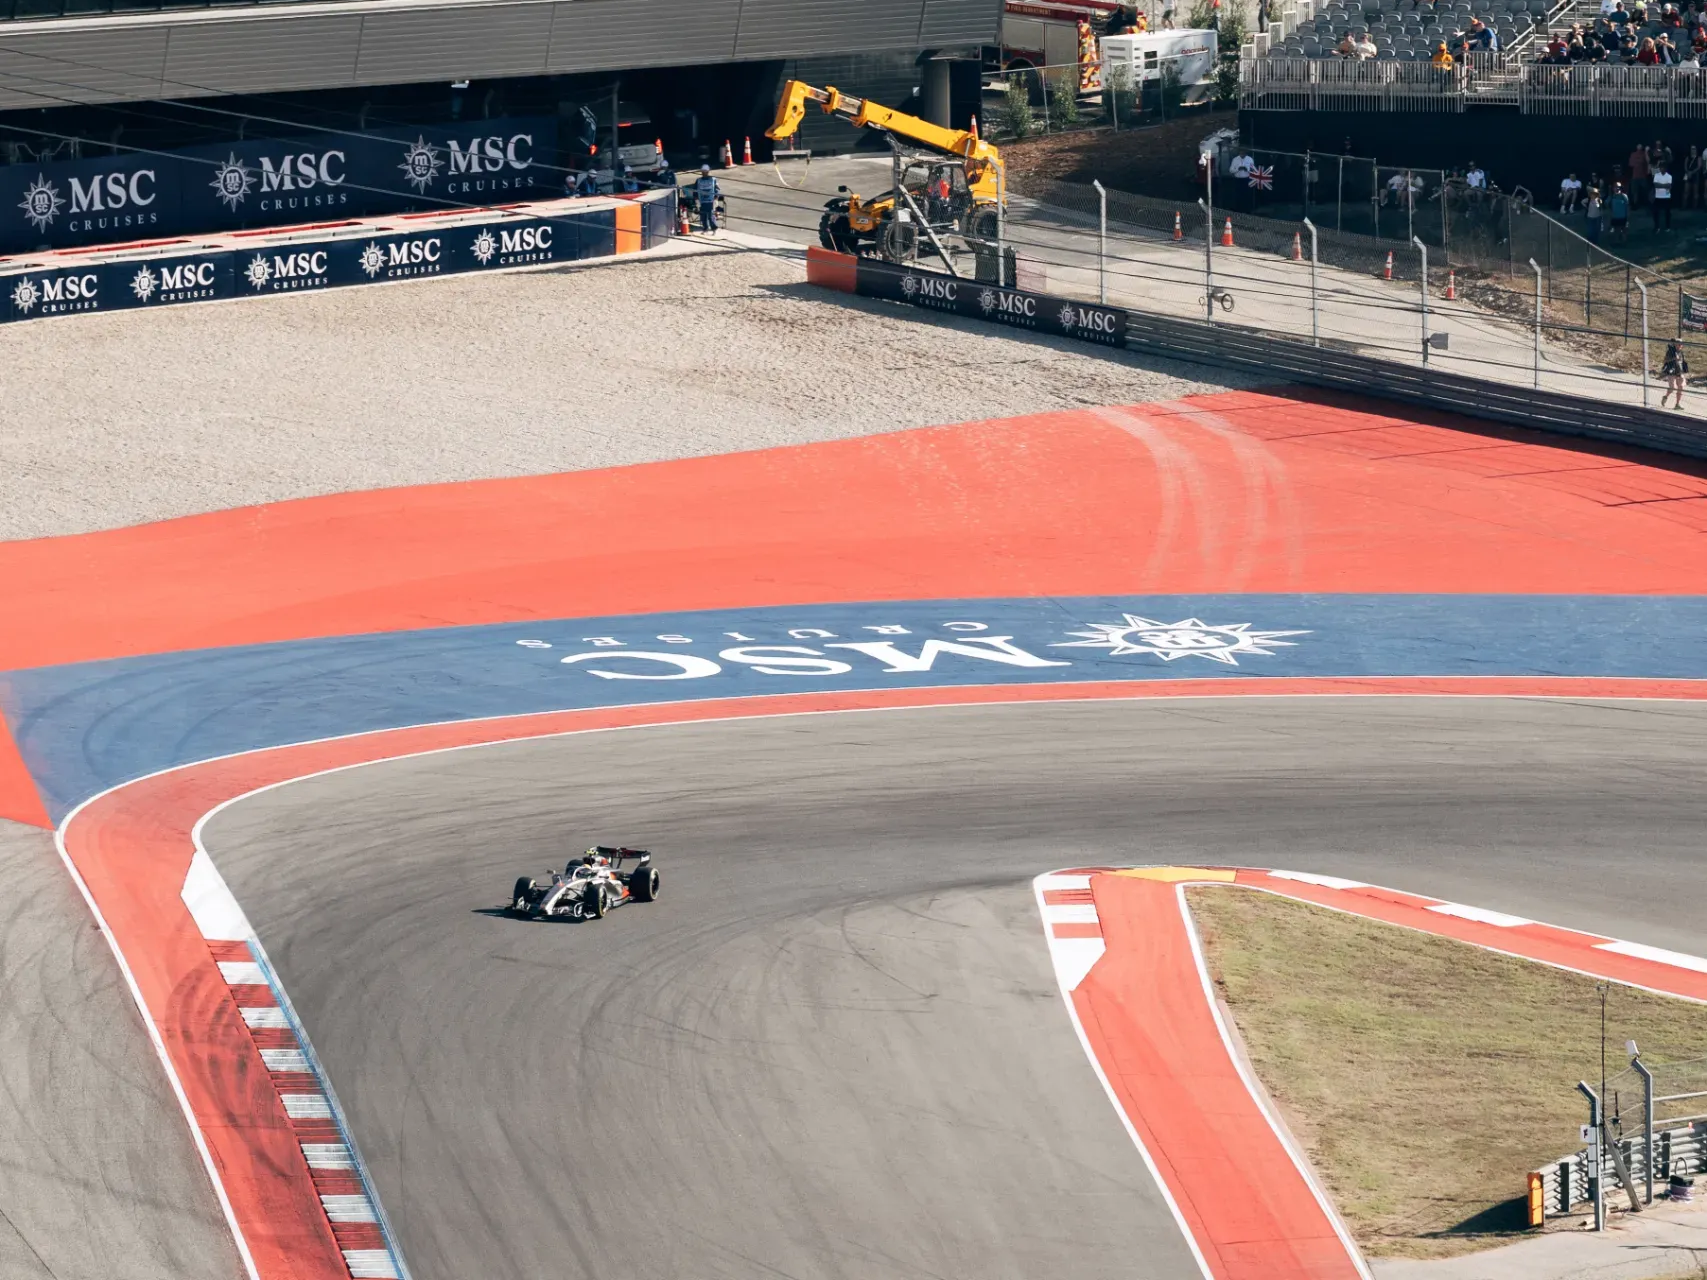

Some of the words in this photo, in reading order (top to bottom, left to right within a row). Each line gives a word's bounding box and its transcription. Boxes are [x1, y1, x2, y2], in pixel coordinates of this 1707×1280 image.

[447, 134, 533, 175] MSC
[259, 151, 346, 193] MSC
[448, 175, 534, 194] CRUISES
[68, 170, 156, 214] MSC
[260, 194, 347, 211] CRUISES
[70, 213, 157, 232] CRUISES
[388, 238, 441, 266] MSC
[501, 226, 552, 253] MSC
[274, 251, 327, 278] MSC
[388, 264, 440, 277] CRUISES
[500, 252, 552, 265] CRUISES
[42, 275, 98, 301] MSC
[161, 263, 215, 290] MSC
[274, 277, 328, 290] CRUISES
[919, 278, 957, 300] MSC
[42, 300, 98, 313] CRUISES
[160, 289, 215, 302] CRUISES
[999, 292, 1036, 316] MSC
[1078, 308, 1116, 333] MSC
[515, 621, 989, 649] CRUISES
[560, 635, 1073, 680] MSC
